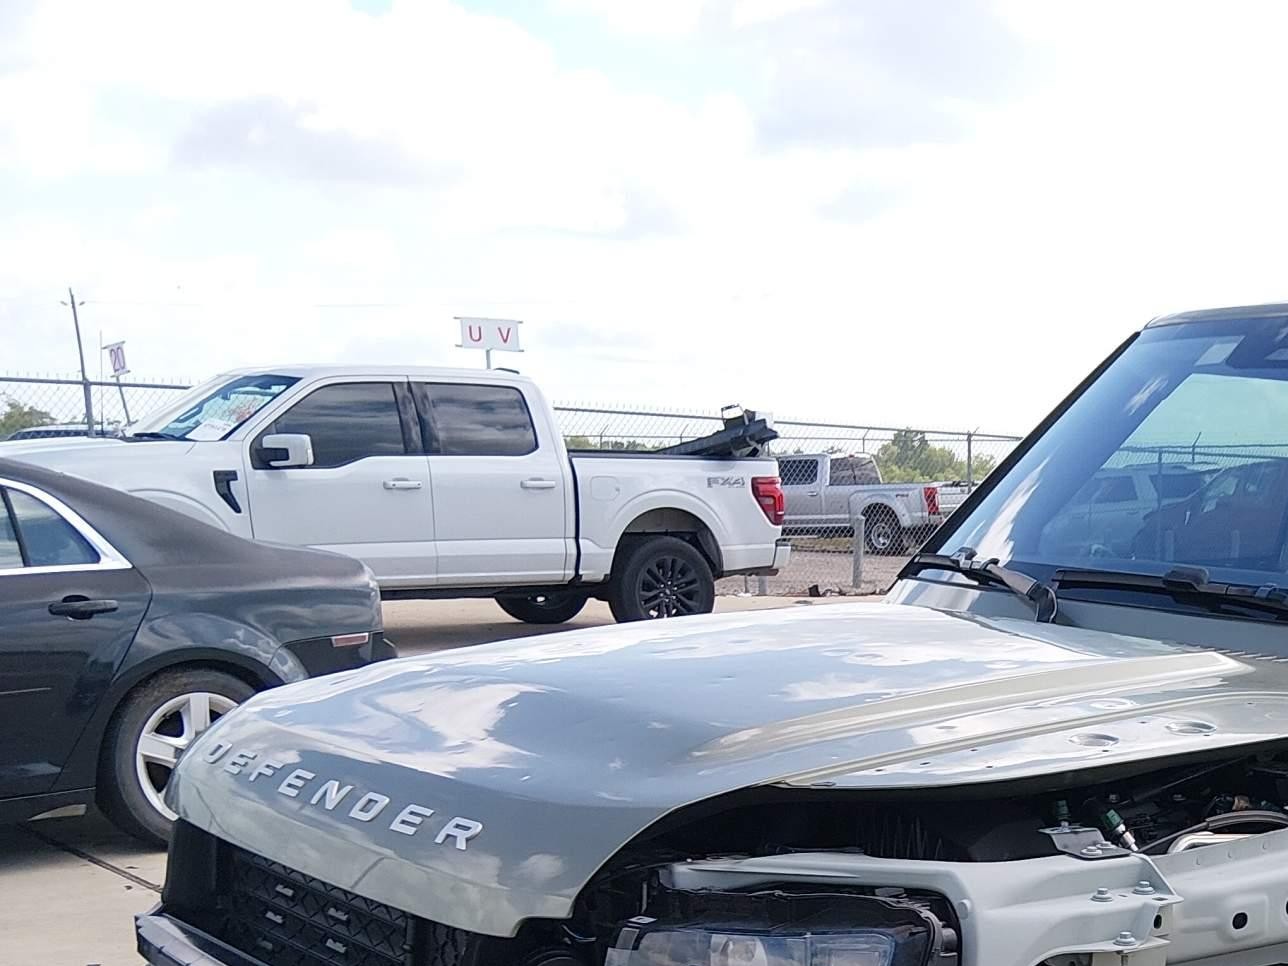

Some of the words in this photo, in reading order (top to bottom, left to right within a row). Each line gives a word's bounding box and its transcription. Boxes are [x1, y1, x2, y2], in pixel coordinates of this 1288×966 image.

[468, 325, 482, 342] U
[497, 327, 512, 344] V
[706, 476, 746, 488] FX4
[202, 740, 484, 851] DEFENDER
